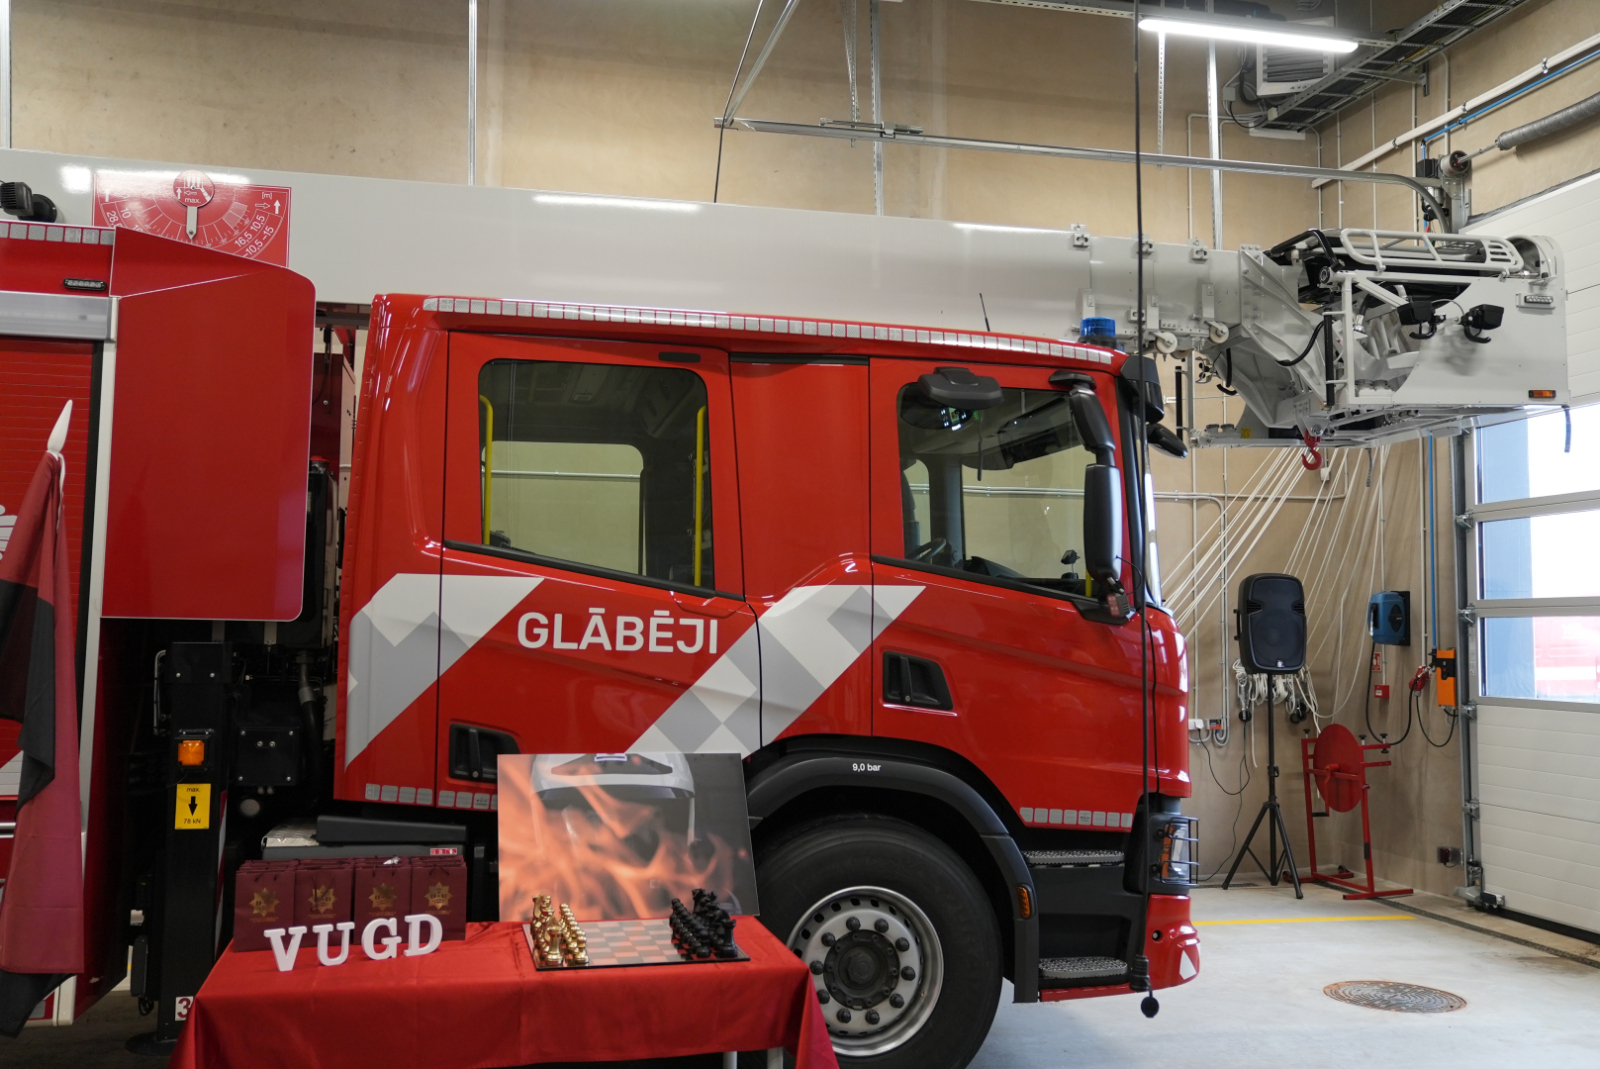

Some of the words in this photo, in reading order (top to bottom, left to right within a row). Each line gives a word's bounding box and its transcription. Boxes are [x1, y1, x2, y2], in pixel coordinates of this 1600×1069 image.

[120, 207, 132, 219] 10
[234, 231, 253, 247] 16,5
[250, 214, 265, 232] 10,5
[517, 607, 718, 654] GLĀBĒJI
[852, 763, 866, 773] 9,0
[867, 763, 881, 772] bar
[263, 913, 443, 972] VUGD
[177, 997, 191, 1019] 3
